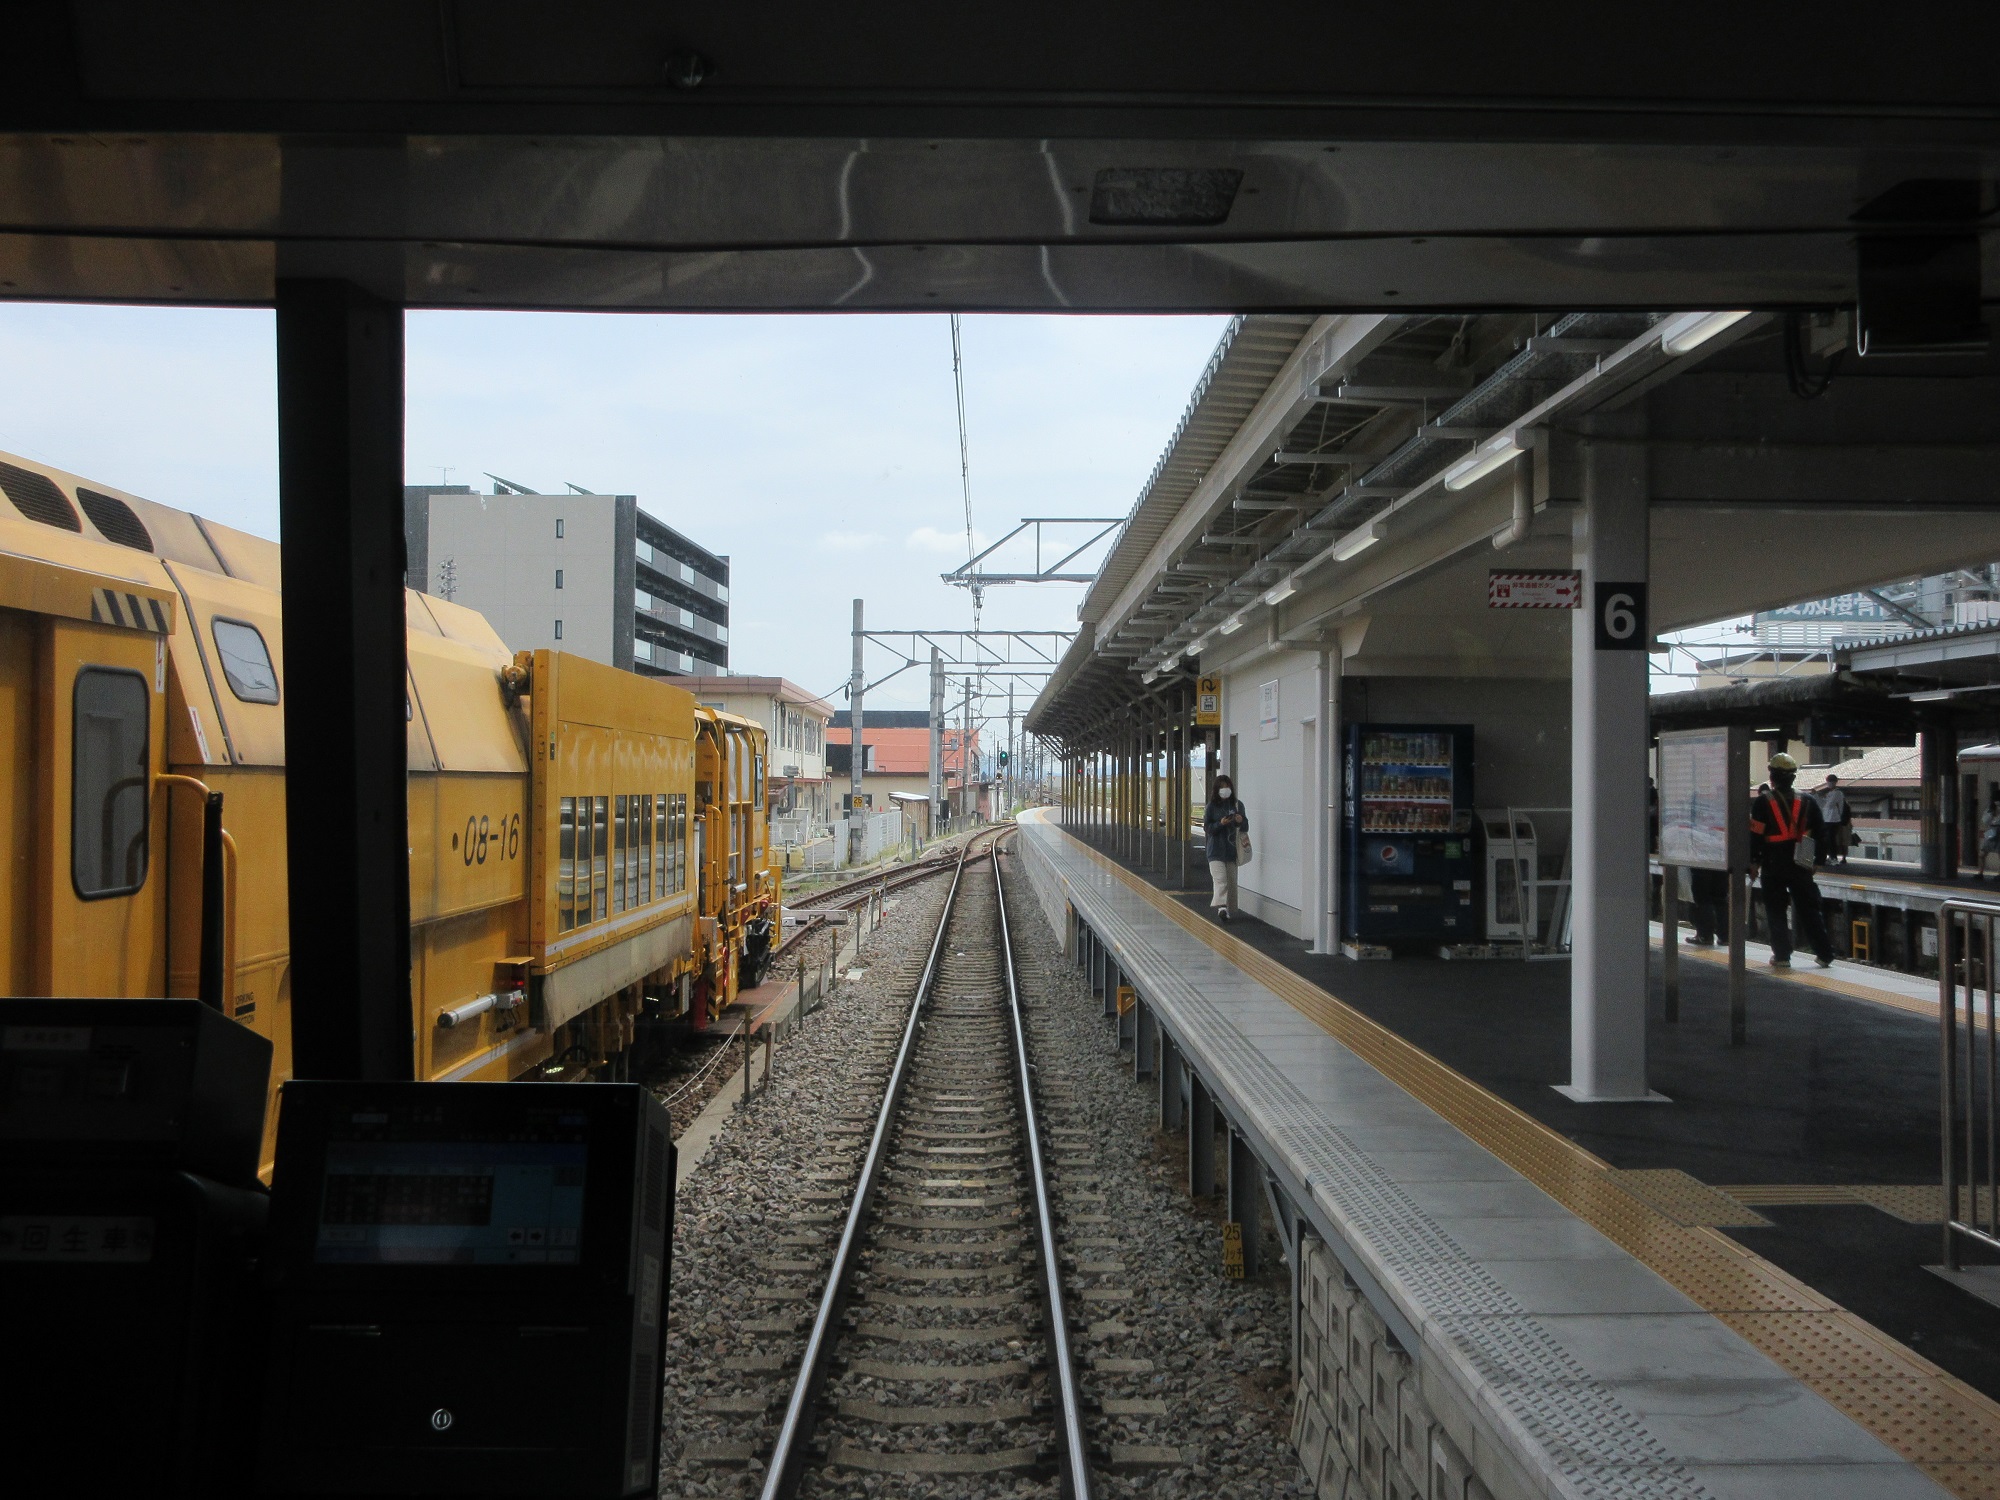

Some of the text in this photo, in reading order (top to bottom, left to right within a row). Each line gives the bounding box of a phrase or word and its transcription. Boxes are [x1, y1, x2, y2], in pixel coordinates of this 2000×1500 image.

[1604, 593, 1636, 640] 6
[464, 813, 520, 866] 08-16
[22, 1224, 128, 1253] 回生車
[1224, 1225, 1240, 1240] 25
[1225, 1264, 1243, 1277] OFF
